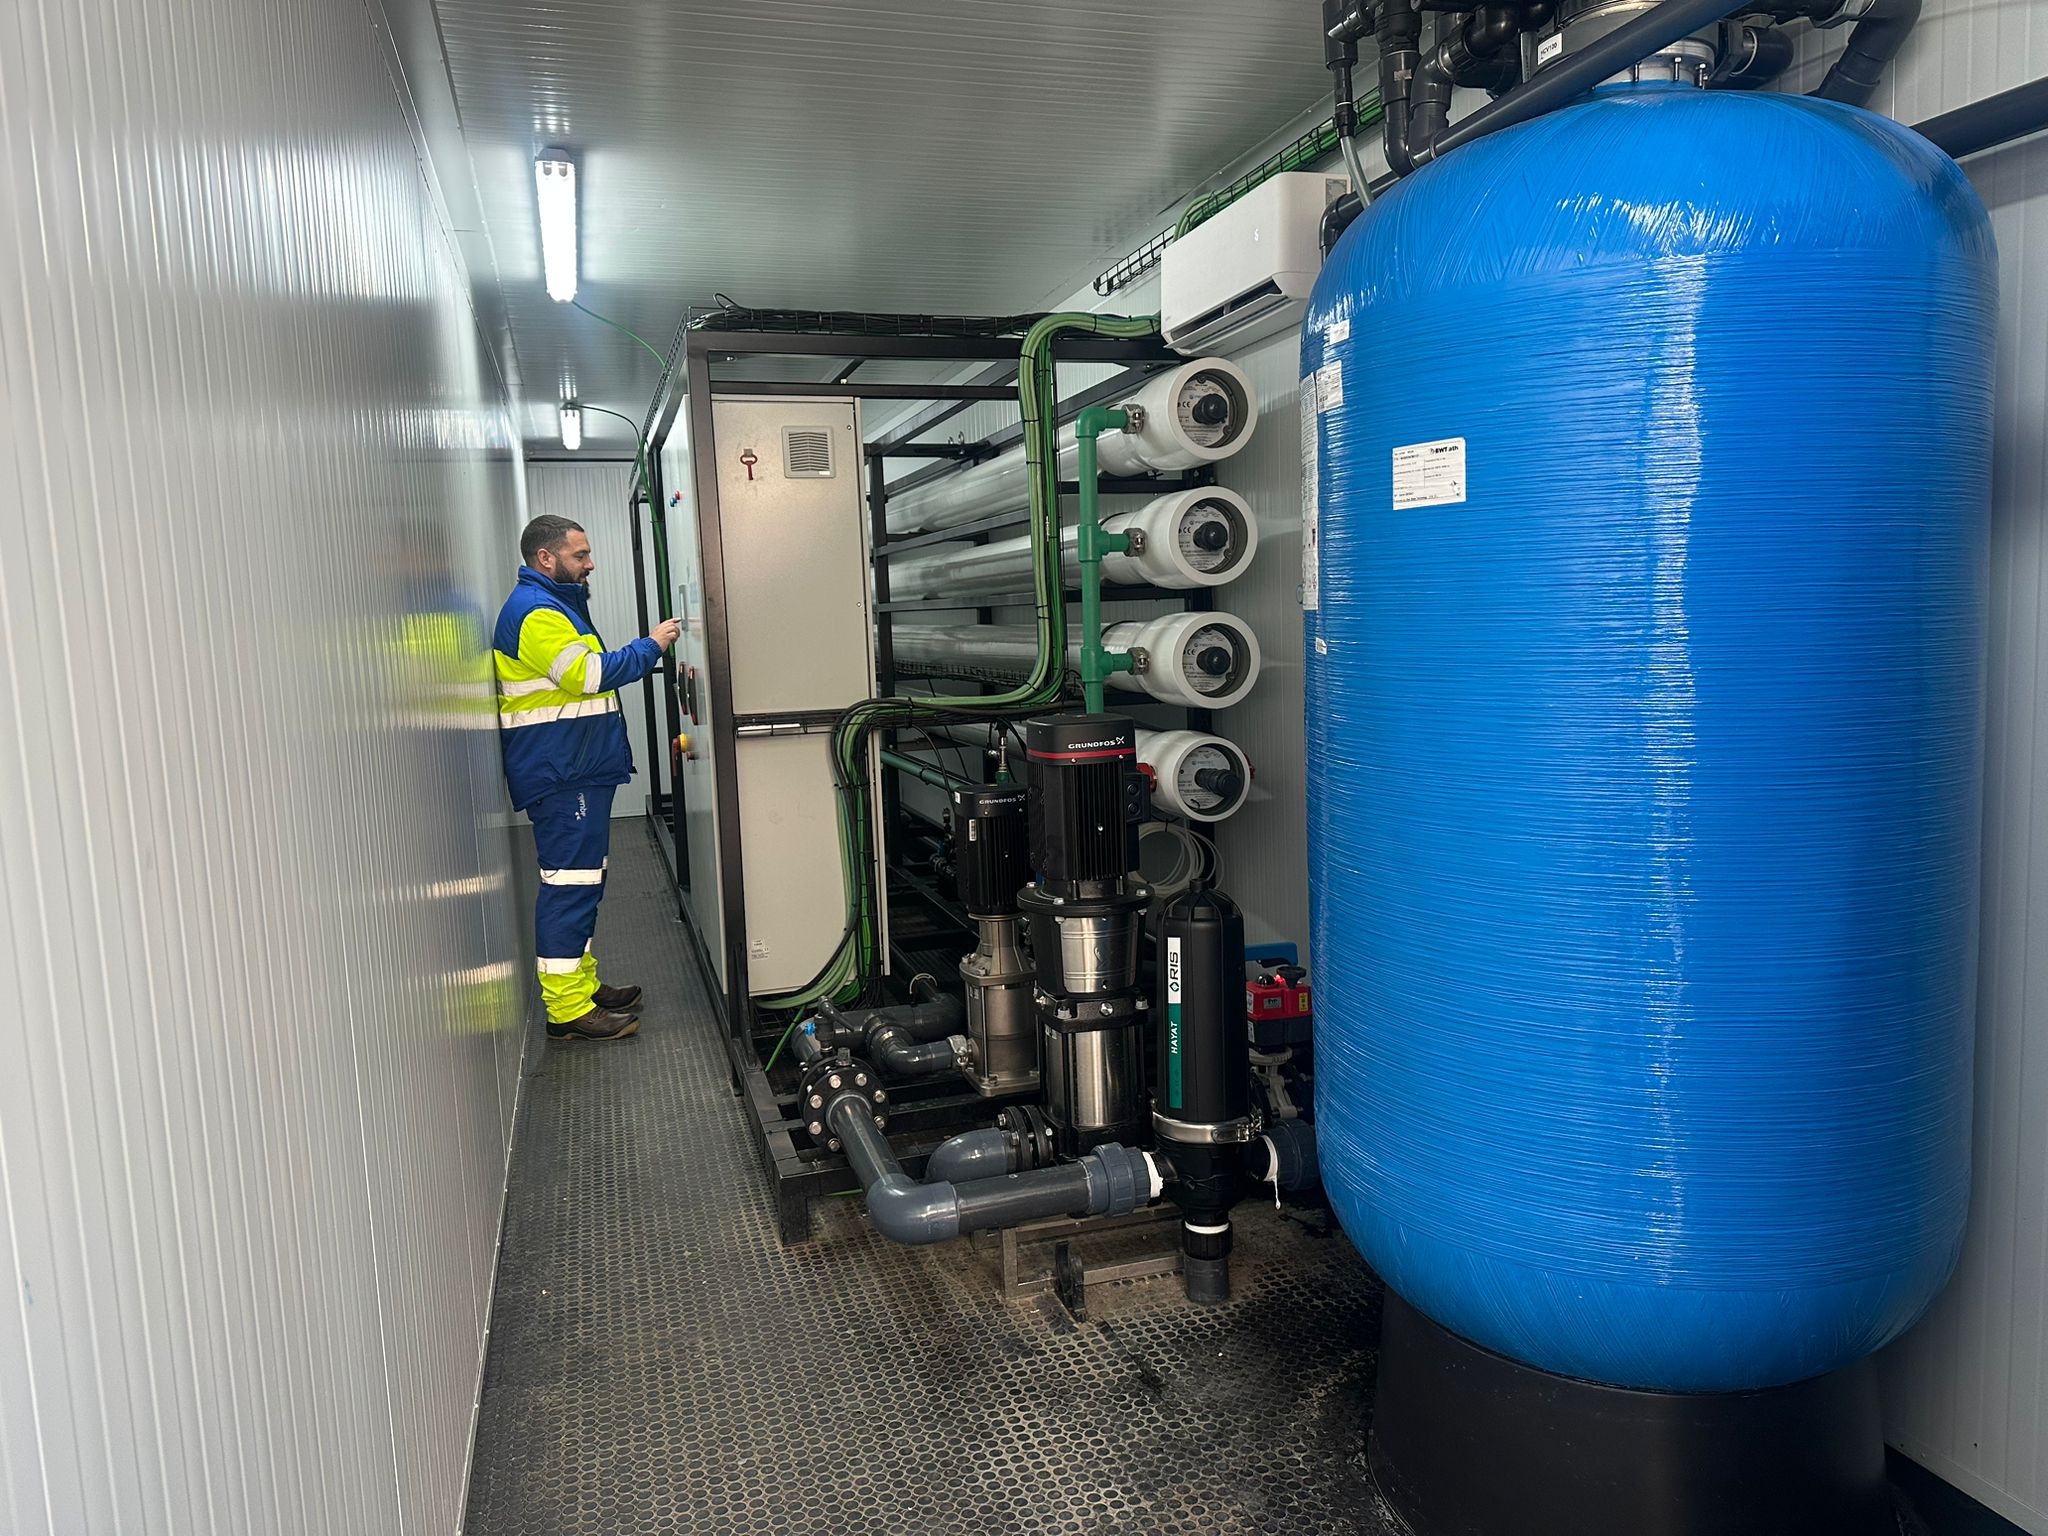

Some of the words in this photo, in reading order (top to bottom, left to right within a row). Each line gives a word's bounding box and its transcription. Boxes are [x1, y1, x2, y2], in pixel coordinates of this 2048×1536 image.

[1067, 739, 1116, 749] GRUNDFOS
[978, 797, 1017, 805] GRUNDFOS
[1170, 1021, 1179, 1054] HAYAT
